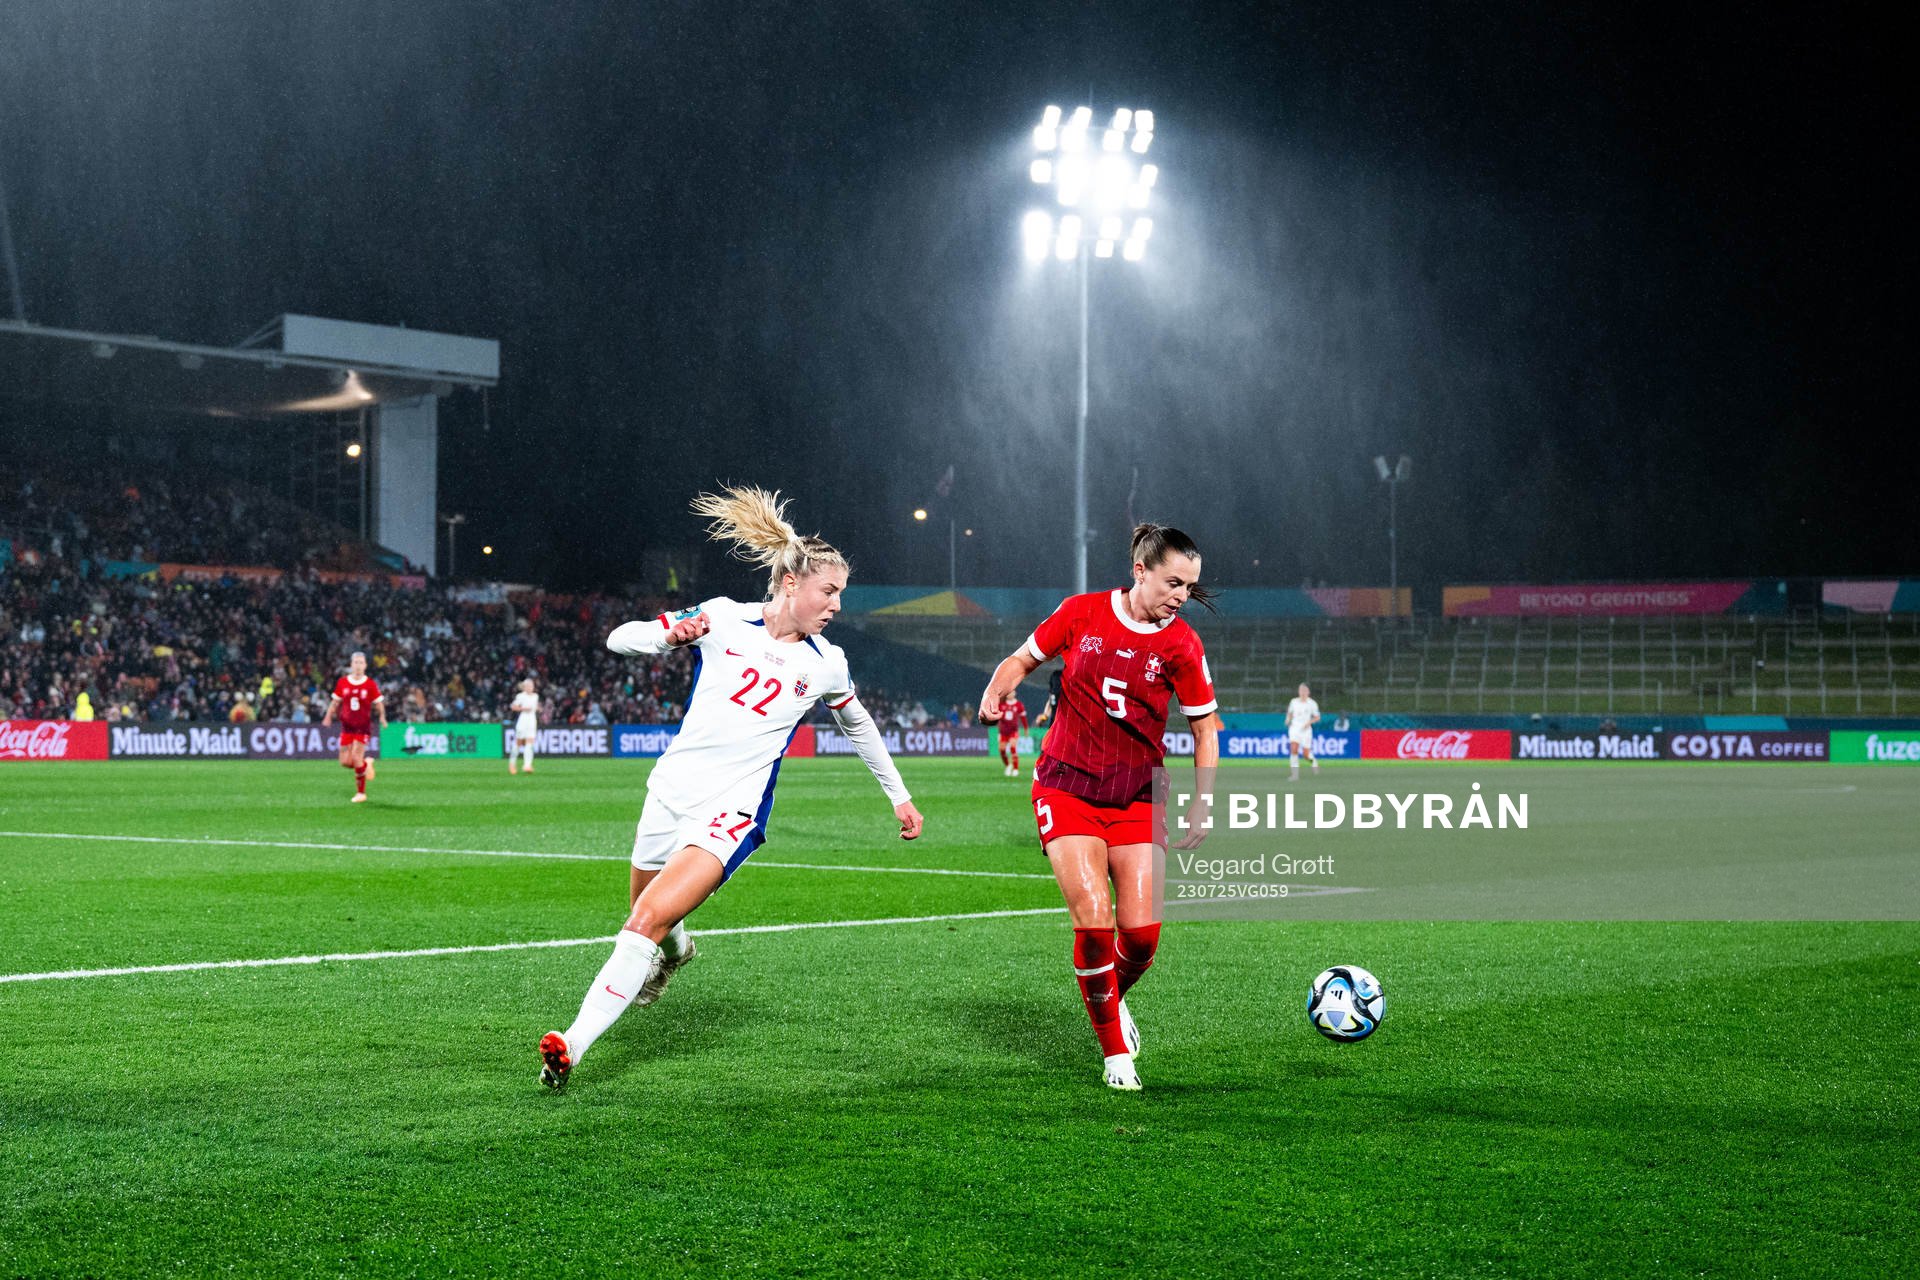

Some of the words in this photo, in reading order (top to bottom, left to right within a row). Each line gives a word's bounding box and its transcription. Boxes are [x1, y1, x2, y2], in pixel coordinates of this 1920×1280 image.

[1519, 593, 1586, 608] BEYOND
[1589, 591, 1690, 607] GREATNESS
[730, 667, 782, 717] 22
[1102, 677, 1128, 719] 5
[112, 727, 187, 755] Minute
[250, 727, 324, 756] COSTA
[505, 728, 609, 754] PWERADE
[905, 731, 953, 754] COSTA
[955, 738, 988, 751] COFFEE
[1518, 735, 1595, 759] Minute
[1671, 735, 1755, 760] COSTA
[1760, 743, 1825, 757] COFFEE
[1037, 798, 1054, 835] 5
